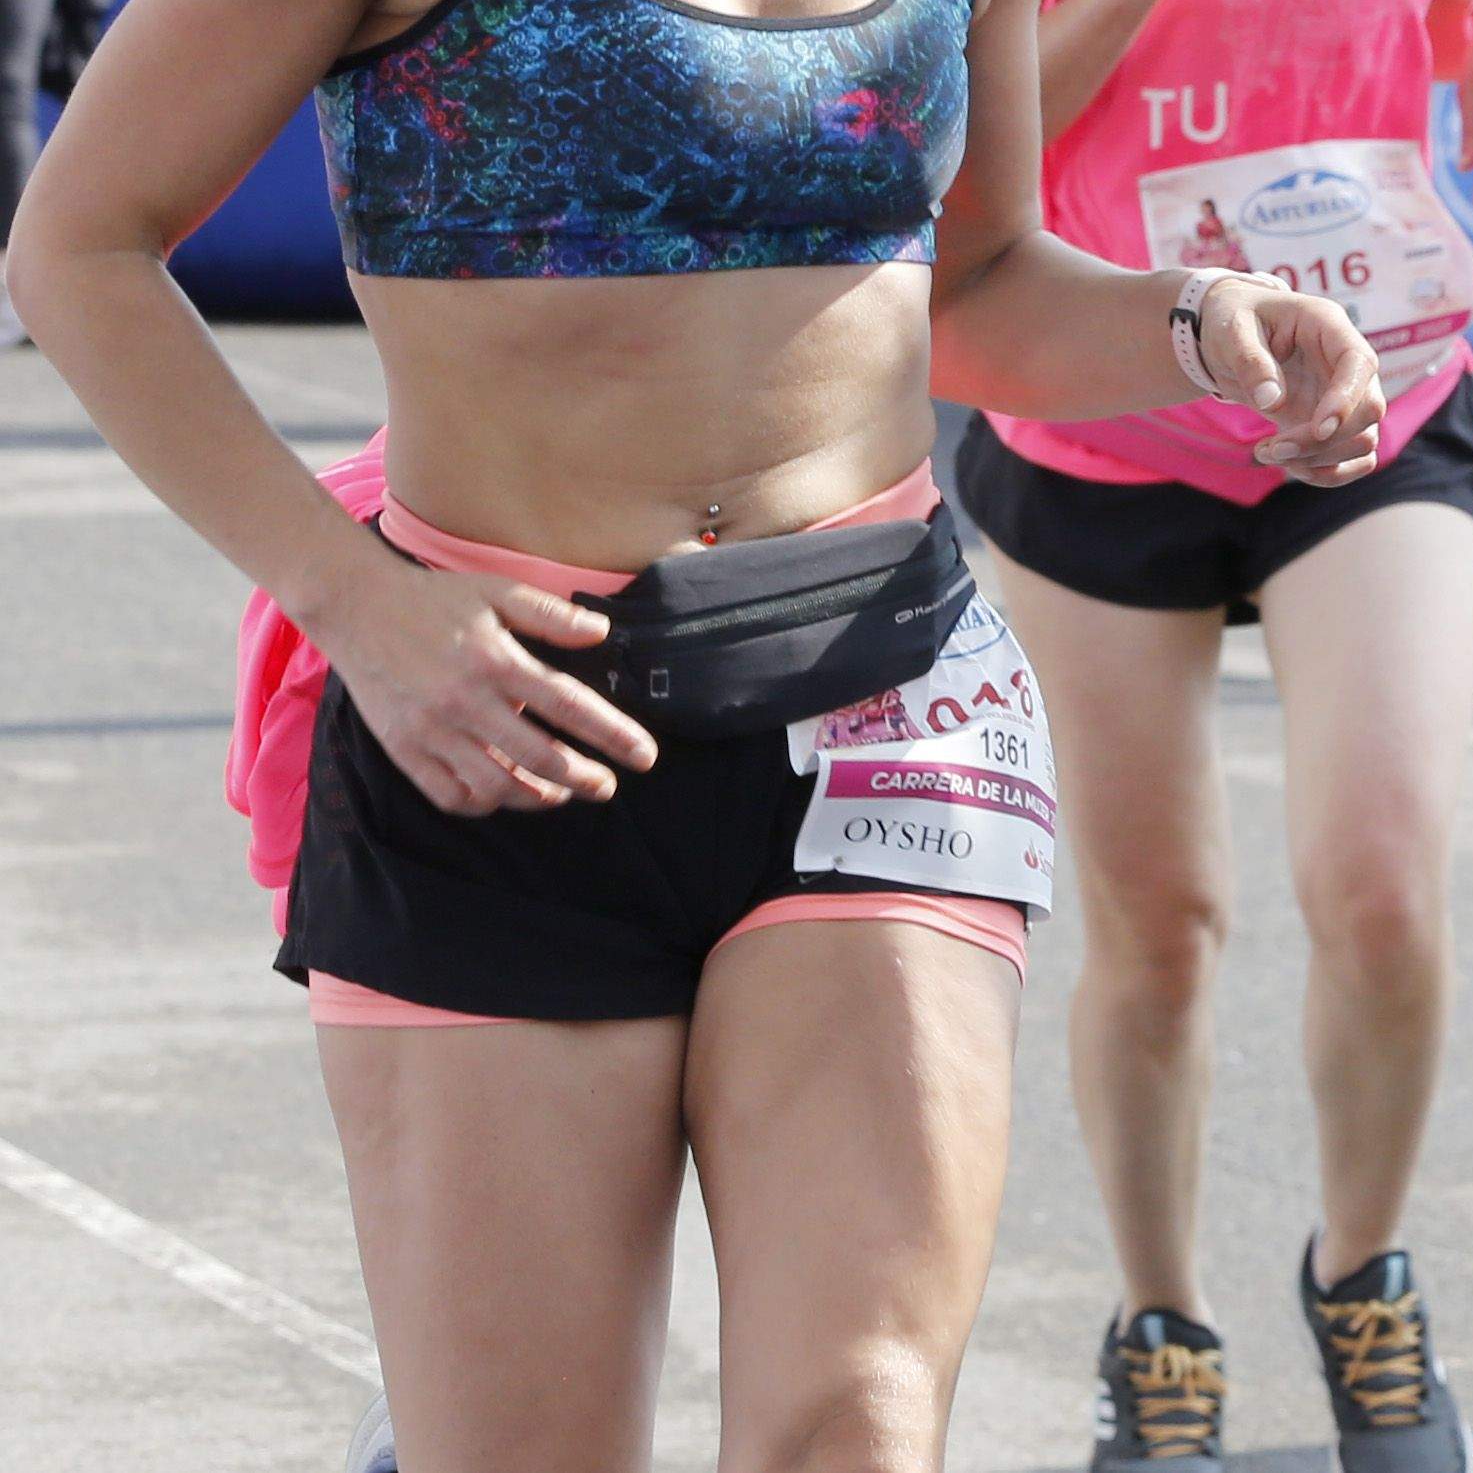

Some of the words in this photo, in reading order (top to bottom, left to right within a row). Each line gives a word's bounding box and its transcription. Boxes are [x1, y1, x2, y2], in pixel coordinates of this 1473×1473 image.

[1141, 81, 1228, 151] TU
[980, 727, 1030, 770] 1361
[870, 771, 975, 798] CARRERA
[978, 779, 1001, 802] DE
[1004, 785, 1023, 809] LA
[843, 816, 974, 860] OYSHO
